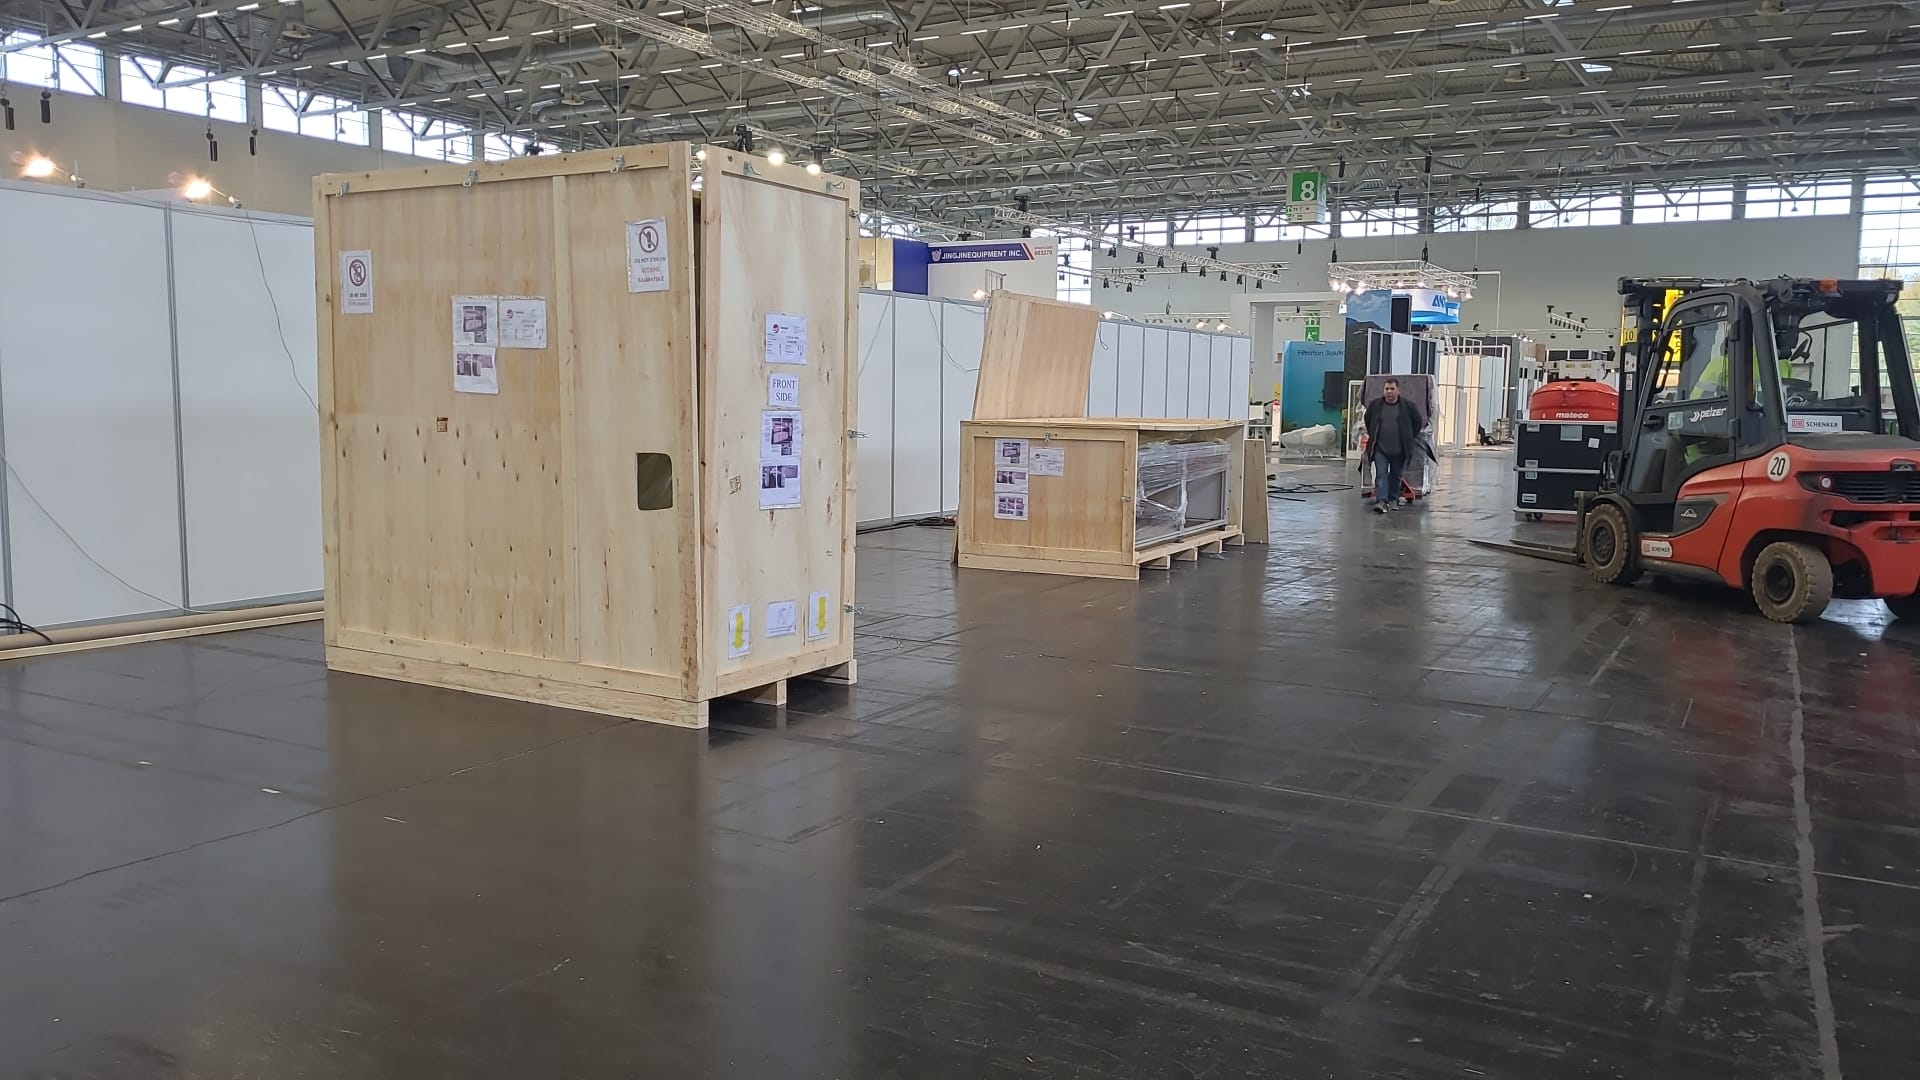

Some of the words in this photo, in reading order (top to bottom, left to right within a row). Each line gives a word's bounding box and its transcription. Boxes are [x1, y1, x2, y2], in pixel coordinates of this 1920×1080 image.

[1300, 180, 1315, 201] 8
[941, 249, 1006, 260] JINGJINEQUIPMENT
[1008, 249, 1023, 257] INC.
[1625, 331, 1634, 341] 10
[772, 379, 796, 389] FRONT
[776, 392, 793, 402] SIDE
[1700, 406, 1727, 421] pelzer
[1770, 457, 1786, 476] 20
